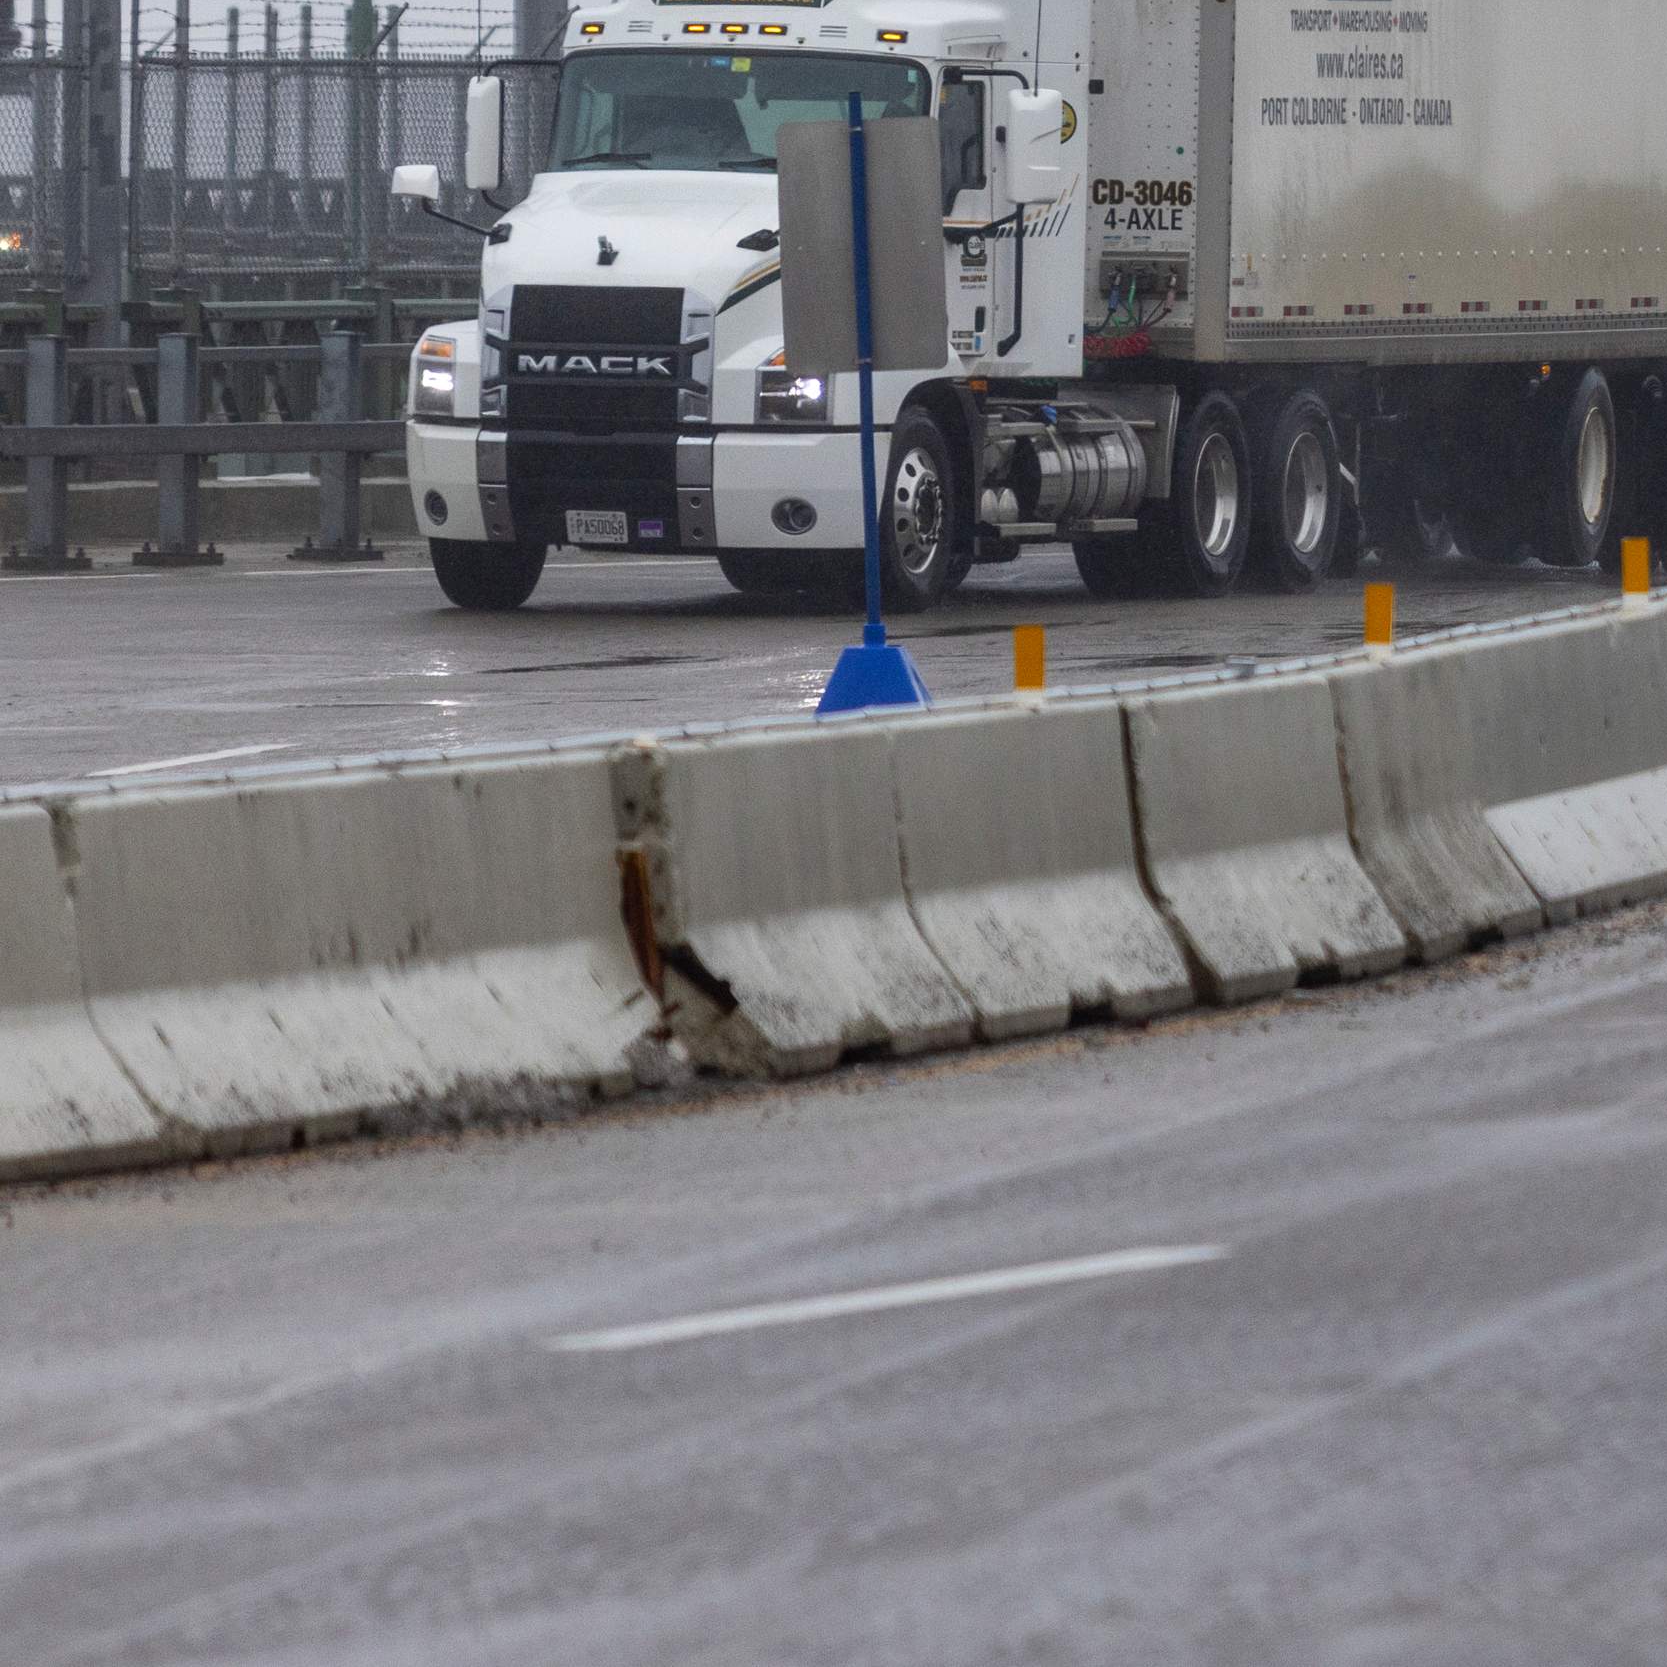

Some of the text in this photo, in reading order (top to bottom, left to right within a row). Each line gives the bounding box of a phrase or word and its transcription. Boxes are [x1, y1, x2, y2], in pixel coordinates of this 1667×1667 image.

[1290, 9, 1428, 32] TRANSPORT WAREHOUSING MOVING
[1316, 45, 1403, 79] www.claires.ca
[1261, 97, 1288, 126] PORT
[1292, 97, 1347, 125] COLBORNE
[1360, 98, 1404, 125] ONTARIO
[1413, 98, 1452, 126] CANADA
[1092, 178, 1193, 206] CD-3046
[1104, 208, 1183, 230] 4-AXLE
[517, 354, 672, 375] MACK
